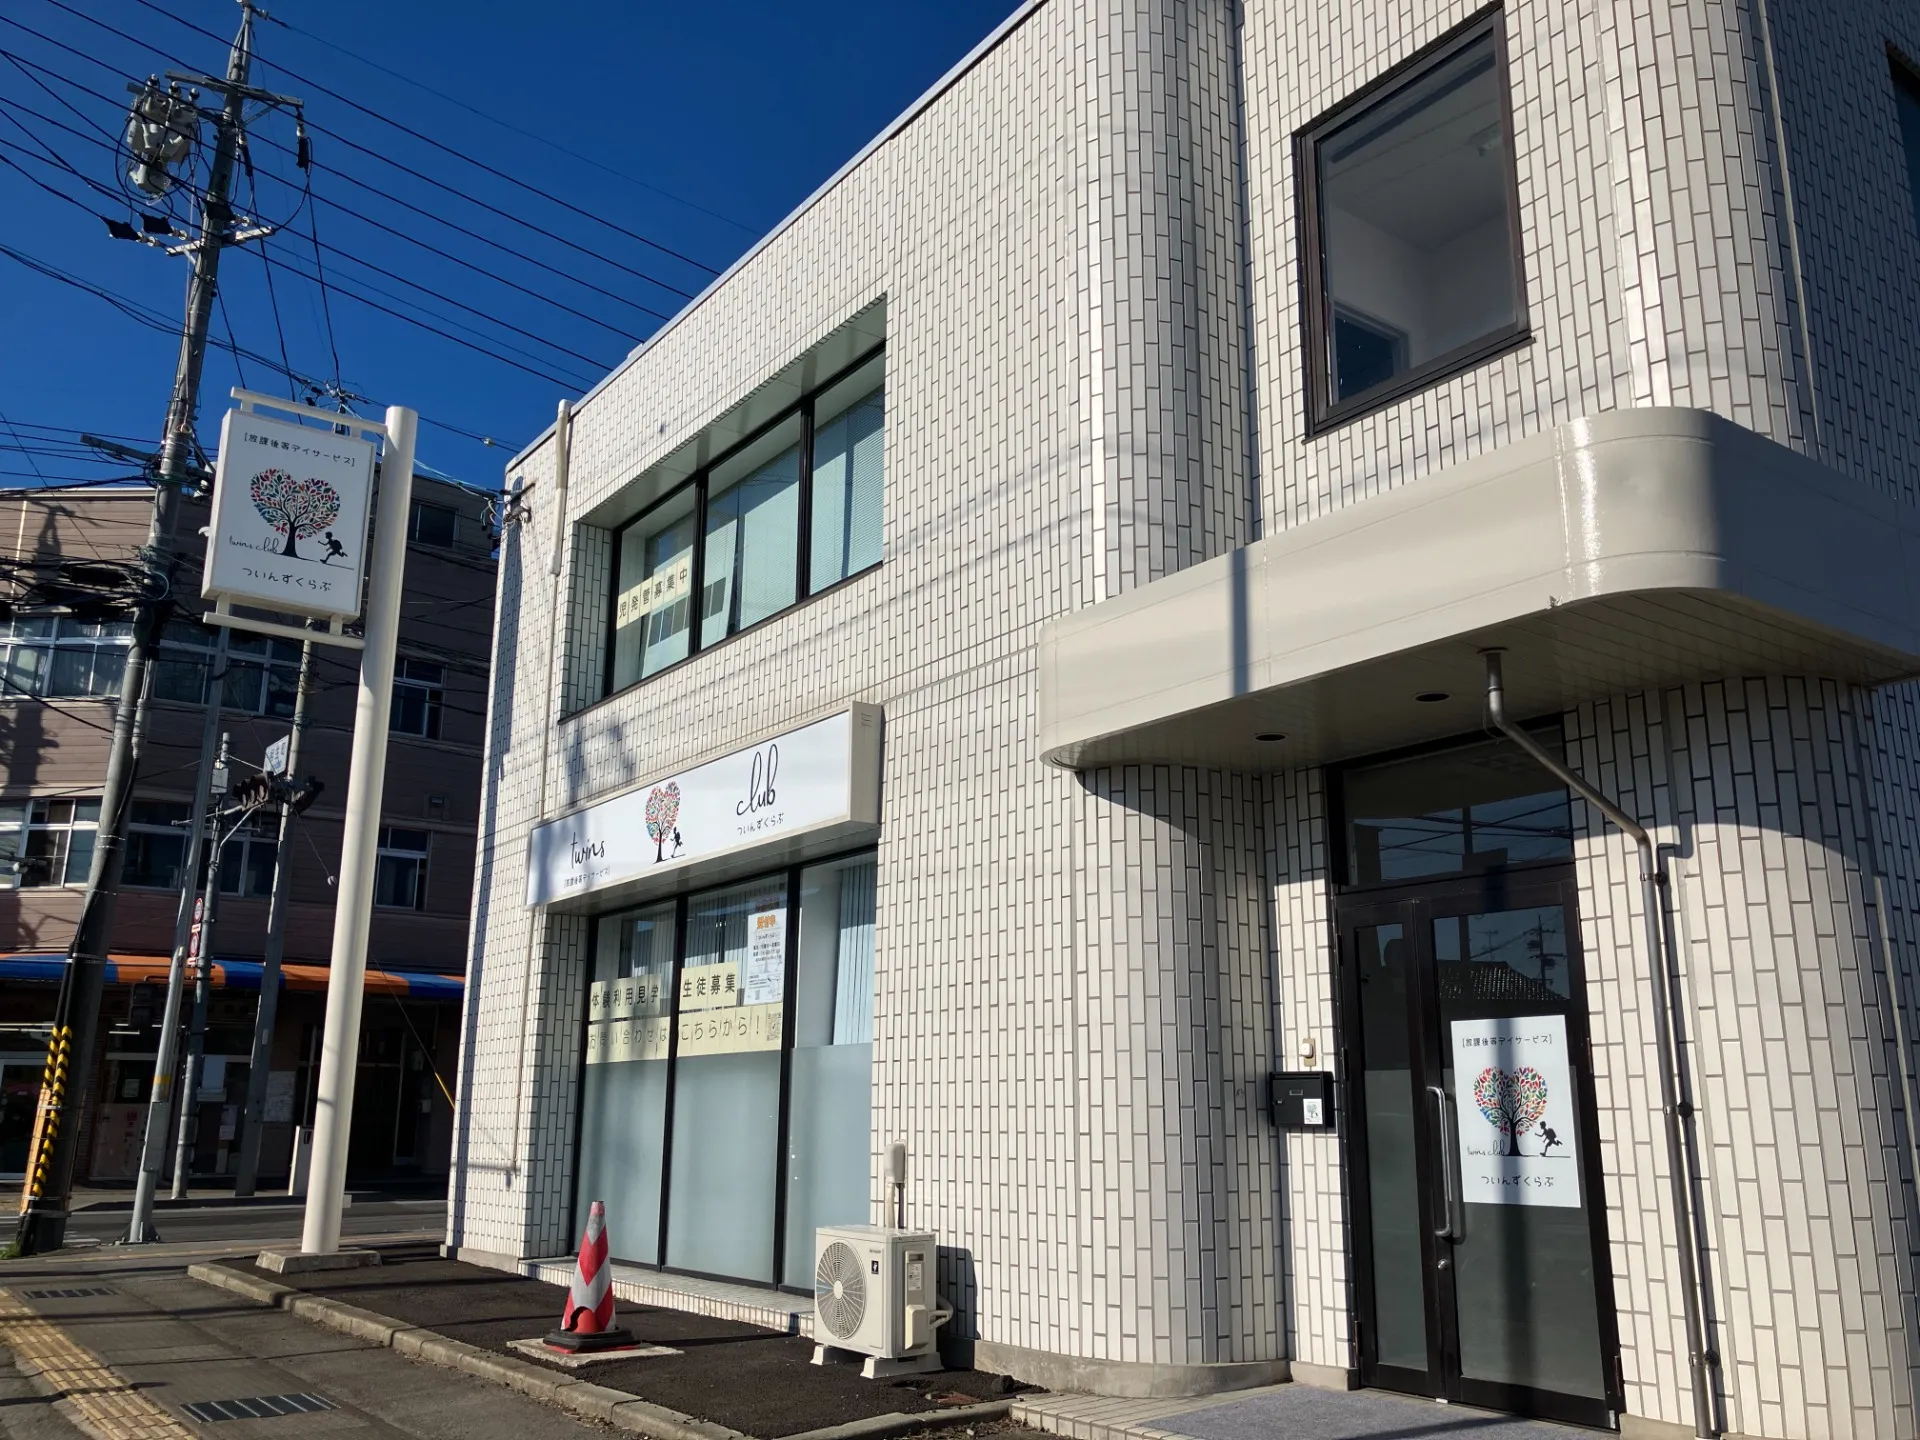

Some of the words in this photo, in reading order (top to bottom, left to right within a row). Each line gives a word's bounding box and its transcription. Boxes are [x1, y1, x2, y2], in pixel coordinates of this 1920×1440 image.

[736, 743, 779, 816] club
[570, 831, 605, 869] twins
[591, 984, 659, 1008] 体験利用見学
[682, 972, 736, 998] 生徒募集
